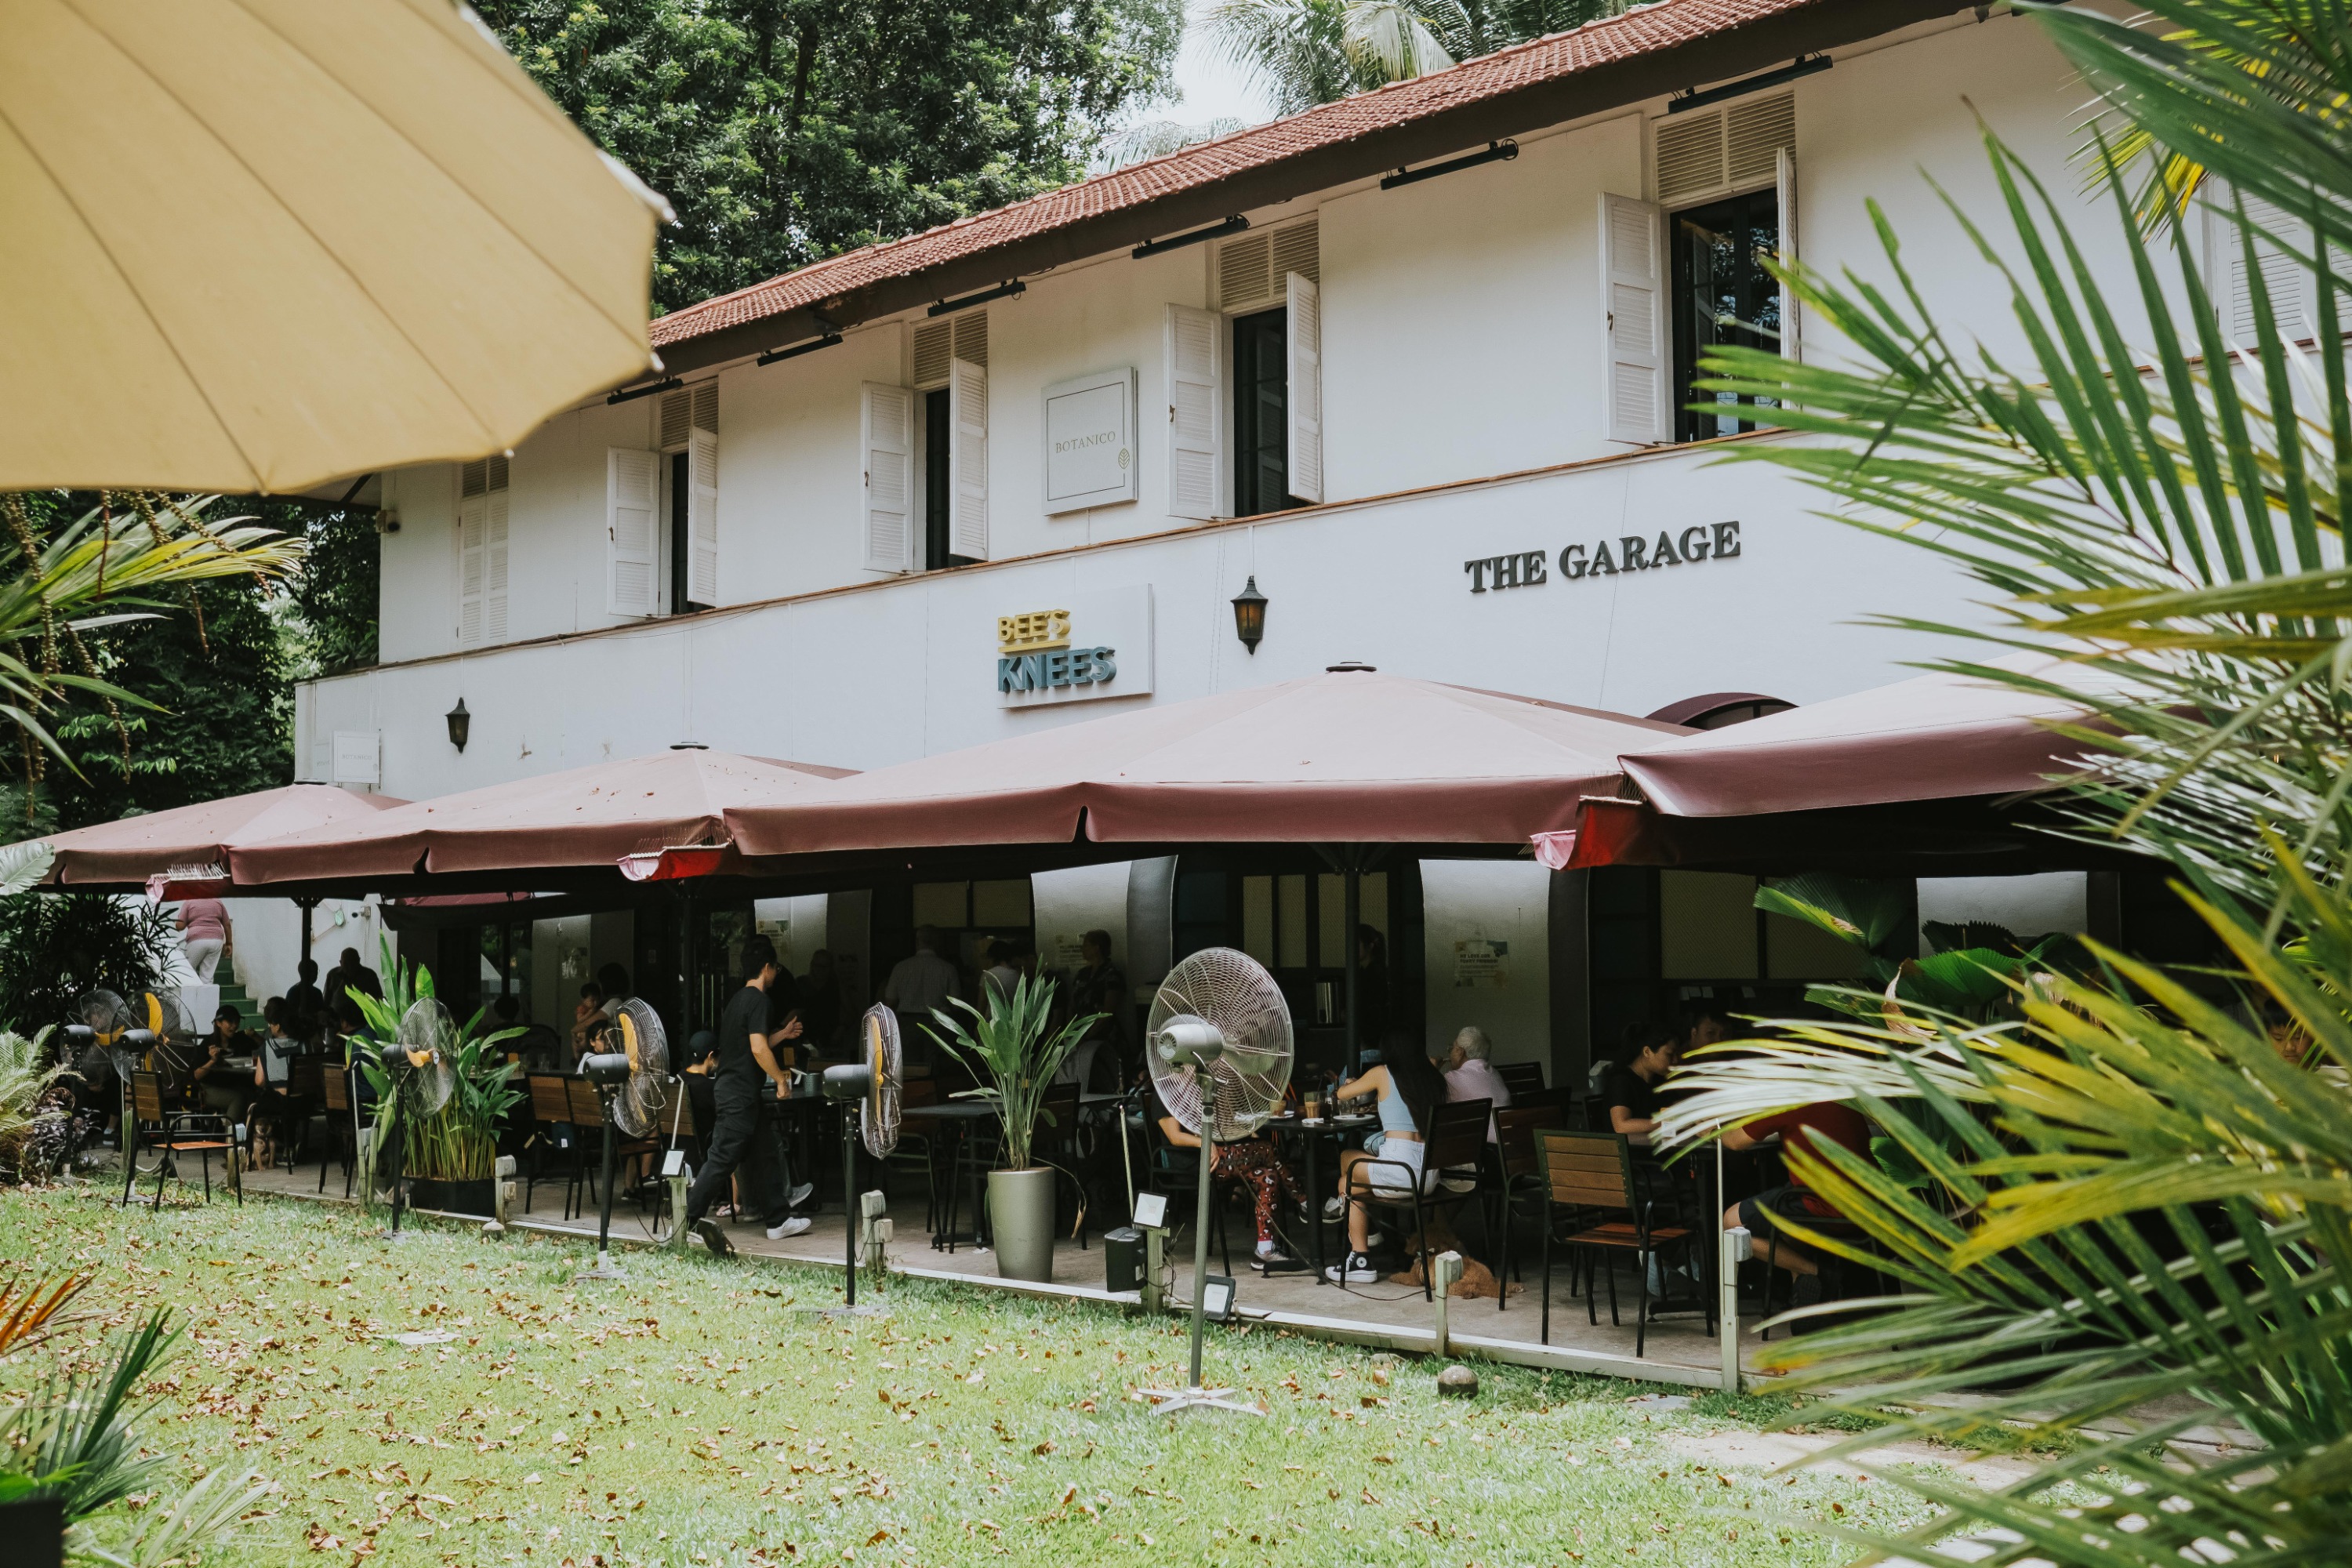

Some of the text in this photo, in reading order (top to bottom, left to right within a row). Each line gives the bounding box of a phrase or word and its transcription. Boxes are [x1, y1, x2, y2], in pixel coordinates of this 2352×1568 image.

[1055, 430, 1116, 453] BOTANICO
[1464, 521, 1741, 593] THE GARAGE
[997, 609, 1071, 642] BEE'S
[997, 646, 1116, 692] KNEES
